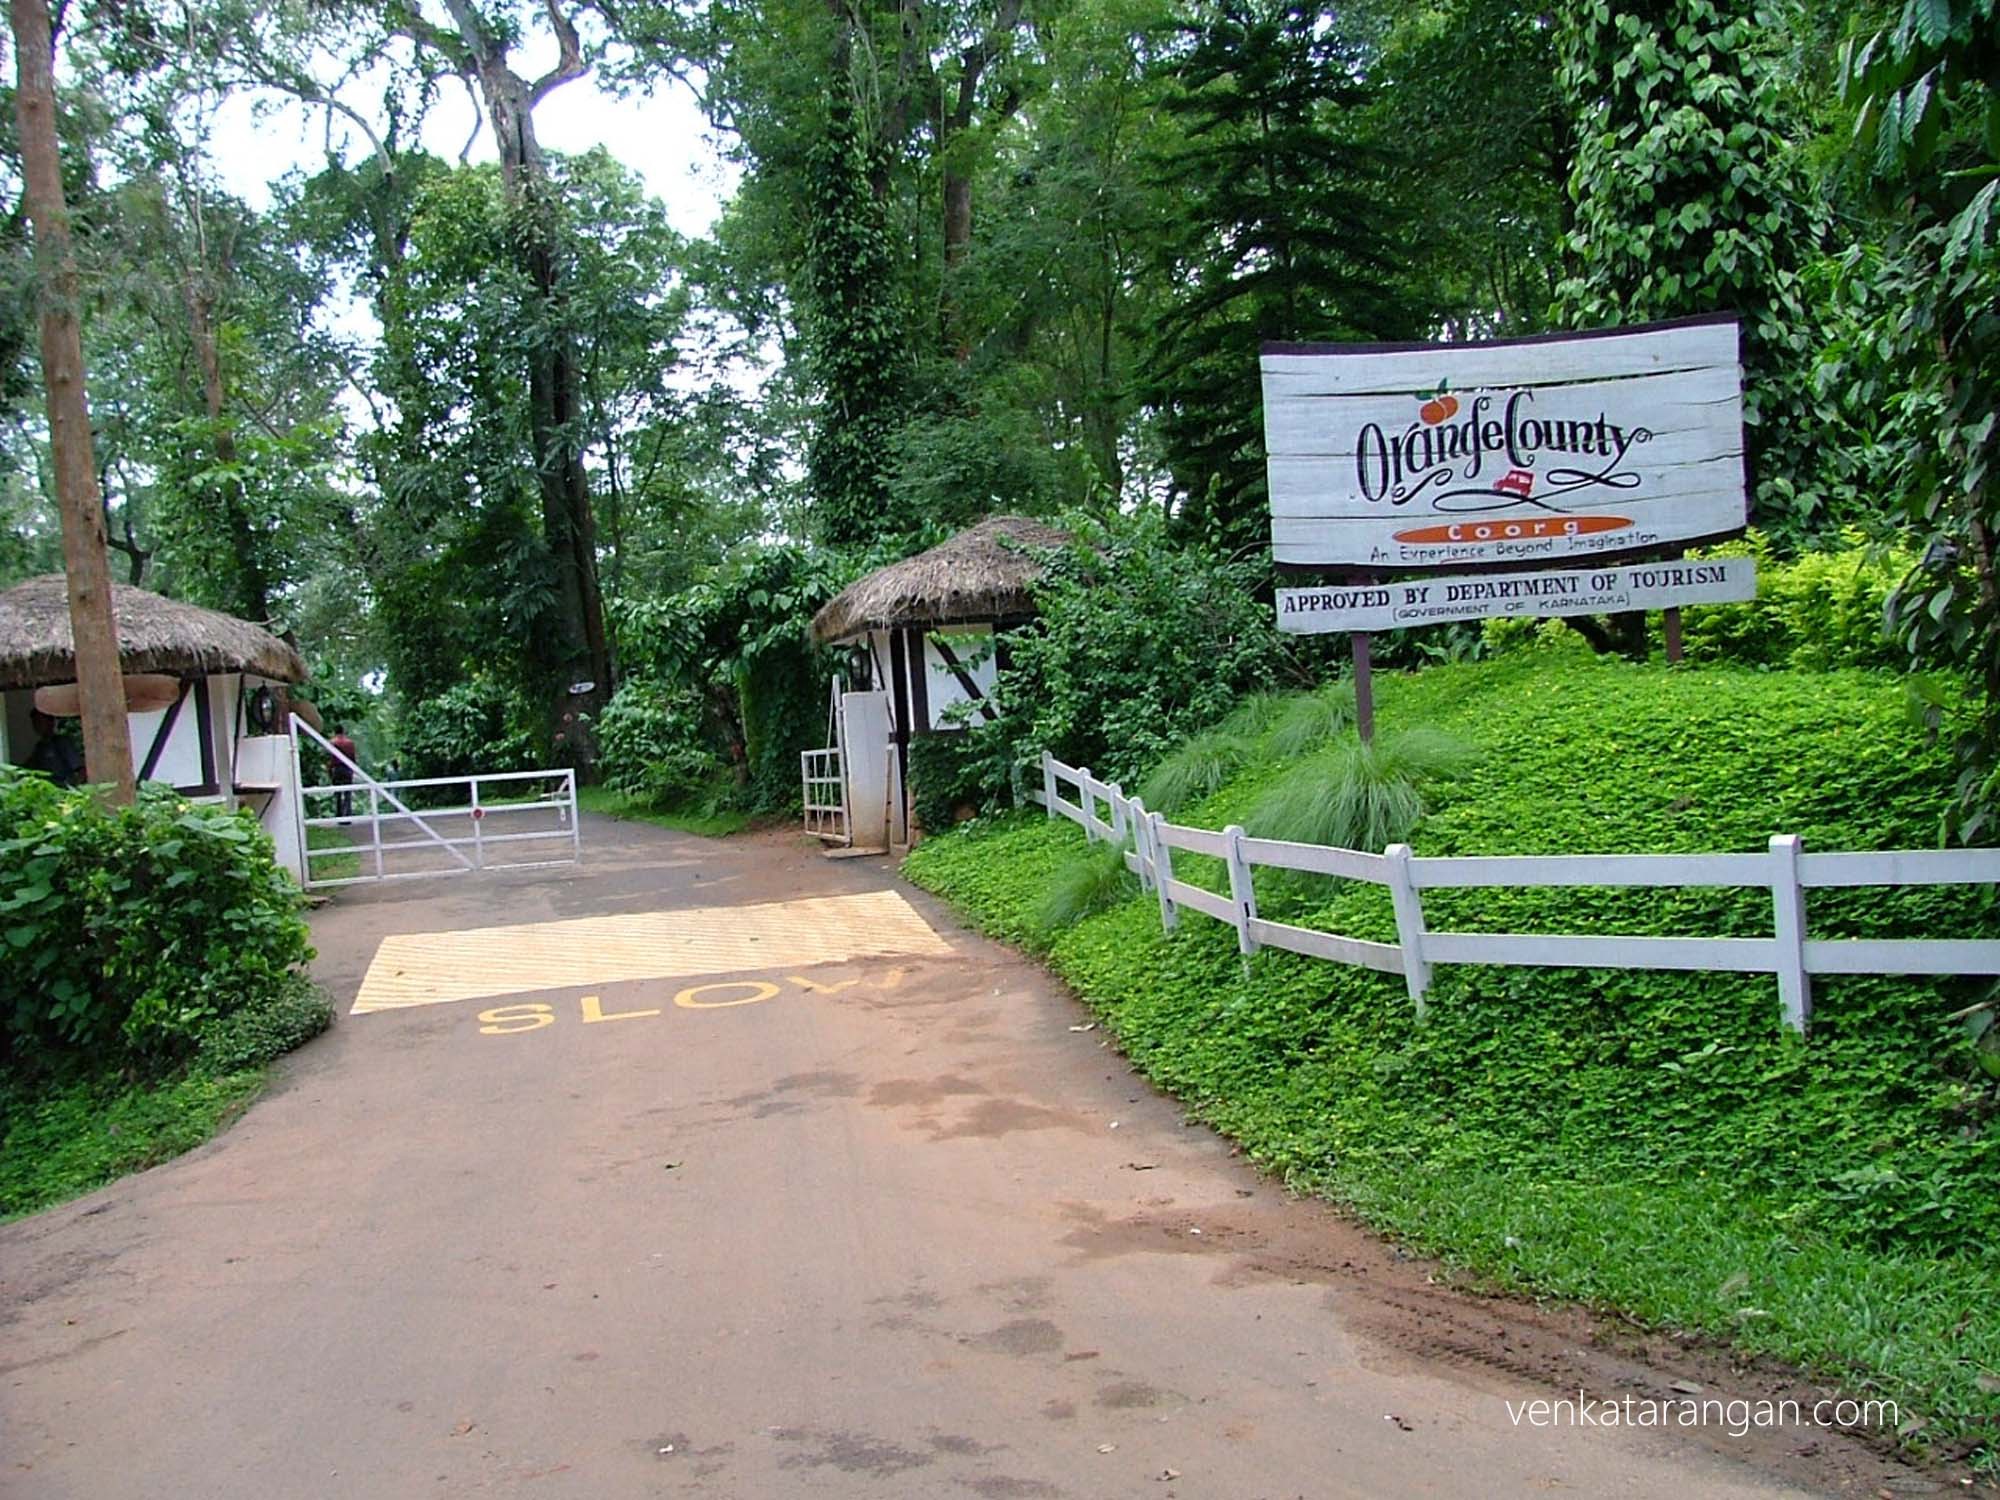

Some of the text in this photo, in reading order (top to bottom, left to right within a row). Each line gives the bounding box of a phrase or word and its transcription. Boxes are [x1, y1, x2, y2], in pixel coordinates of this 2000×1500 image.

[1356, 391, 1652, 505] Orange County
[1370, 532, 1659, 562] An Experience Beyond Imagination
[1284, 565, 1727, 614] APPROVED BY DEPARTMENT OF TOURISM
[1504, 601, 1526, 612] OF
